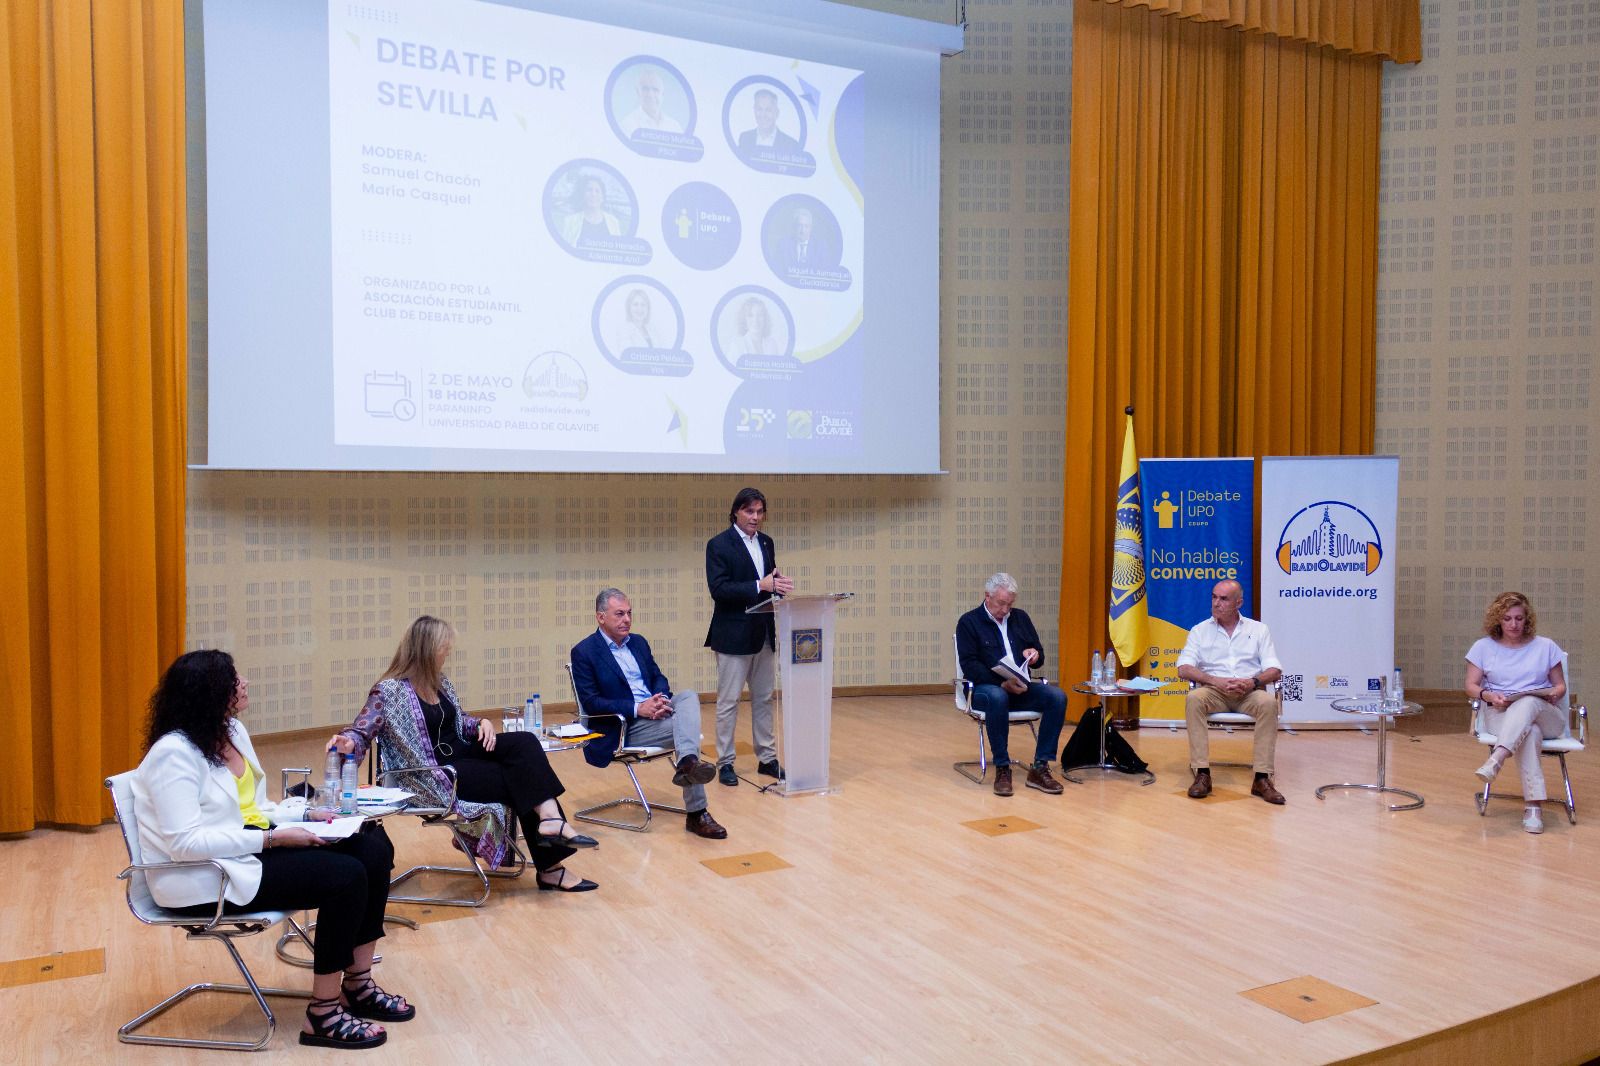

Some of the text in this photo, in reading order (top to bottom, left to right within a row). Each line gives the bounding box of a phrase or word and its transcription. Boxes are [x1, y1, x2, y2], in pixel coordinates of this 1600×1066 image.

[377, 37, 566, 91] DEBATE POR
[377, 80, 499, 122] SEVILLA
[361, 144, 427, 164] MODERA:
[361, 163, 481, 188] Samuel Chacón
[362, 182, 471, 205] María Casquel
[700, 211, 732, 223] Debate
[700, 224, 718, 233] UPO
[363, 275, 492, 296] ORGANIZADO POR LA
[364, 291, 522, 313] ASOCIACIÓN ESTUDIANTIL
[363, 306, 492, 326] CLUB DE DEBATE UPO
[428, 373, 513, 388] 2 DE MAYO
[428, 389, 496, 402] 18 HORAS
[428, 404, 492, 414] PARANINFO
[429, 418, 599, 432] UNIVERSIDAD PABLO DE OLAVIDE
[1188, 490, 1241, 502] Debate
[1188, 505, 1215, 517] UPO
[1151, 547, 1244, 566] No hables,
[1151, 567, 1237, 580] convence
[1279, 586, 1378, 599] radiolavide.org
